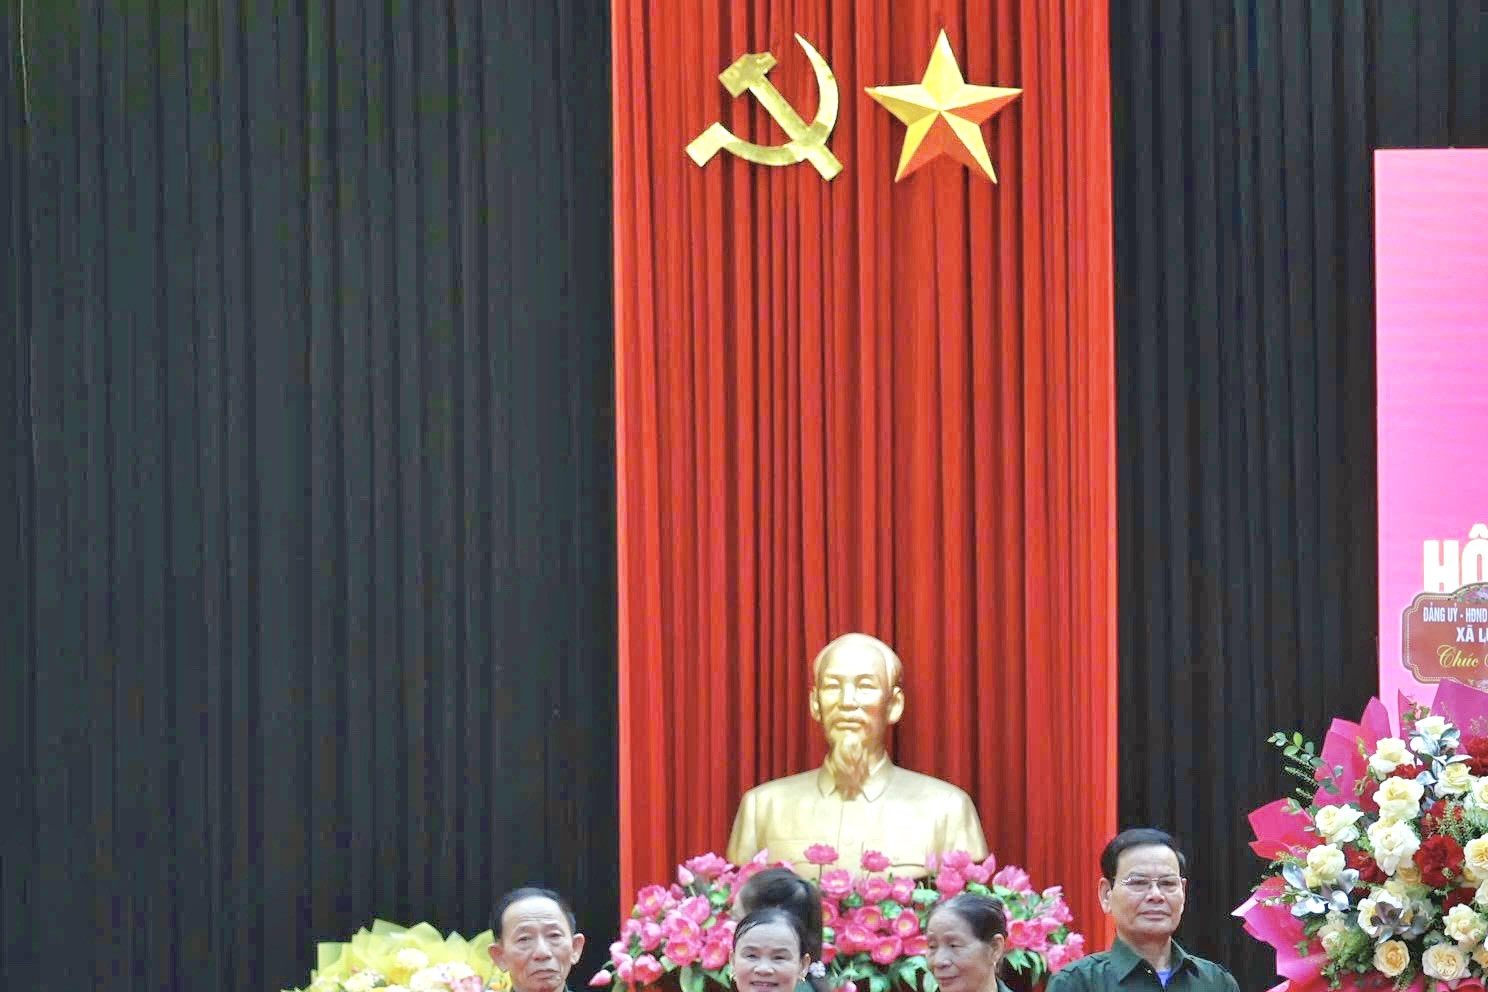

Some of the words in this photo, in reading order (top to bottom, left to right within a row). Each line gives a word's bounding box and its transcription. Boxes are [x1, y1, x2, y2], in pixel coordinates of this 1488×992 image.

[1423, 602, 1446, 623] ĐẢNG
[1466, 607, 1488, 623] HĐND
[1456, 625, 1475, 642] XÃ
[1437, 644, 1479, 667] Chúc
